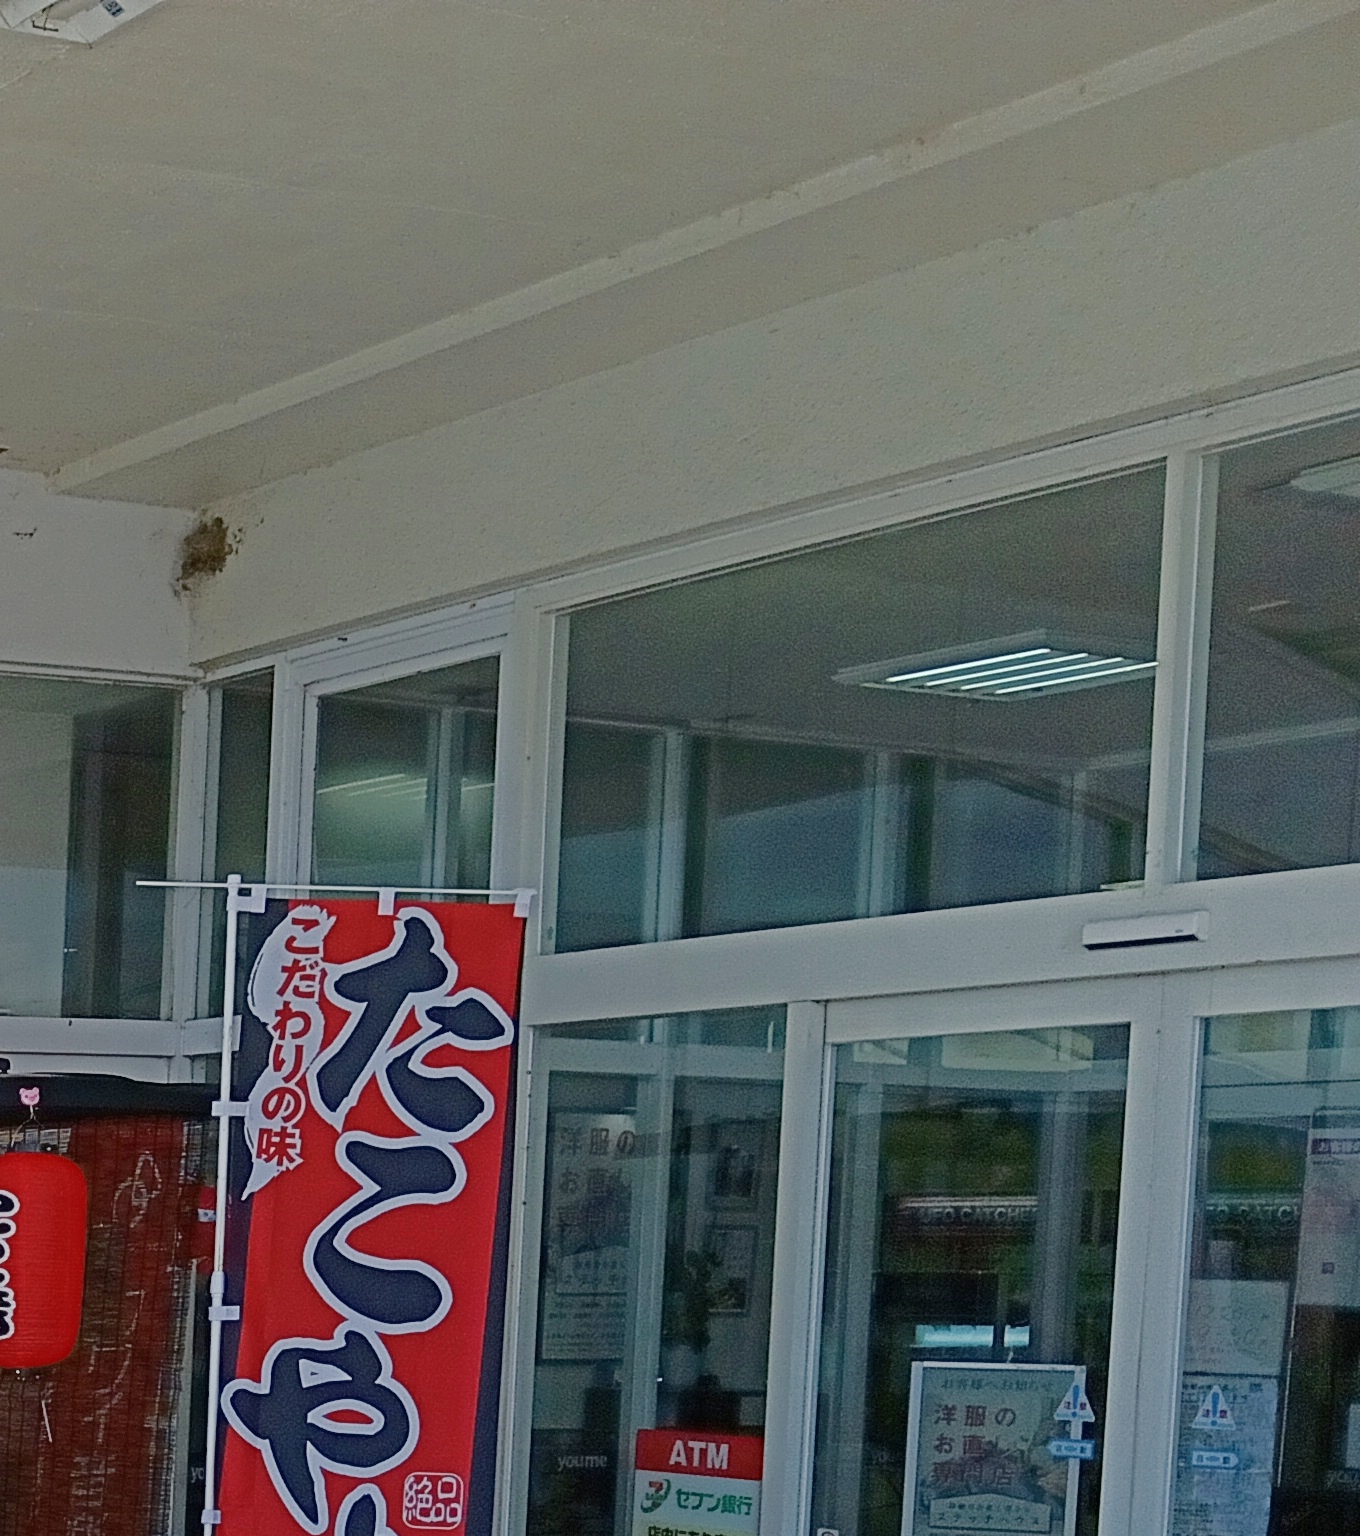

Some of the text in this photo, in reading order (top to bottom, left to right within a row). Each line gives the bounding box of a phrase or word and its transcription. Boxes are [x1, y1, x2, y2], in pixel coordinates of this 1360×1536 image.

[255, 914, 324, 1168] こだわりの味
[934, 1402, 1017, 1427] 洋服の
[668, 1439, 730, 1470] ATM
[675, 1488, 753, 1516] セブン銀行
